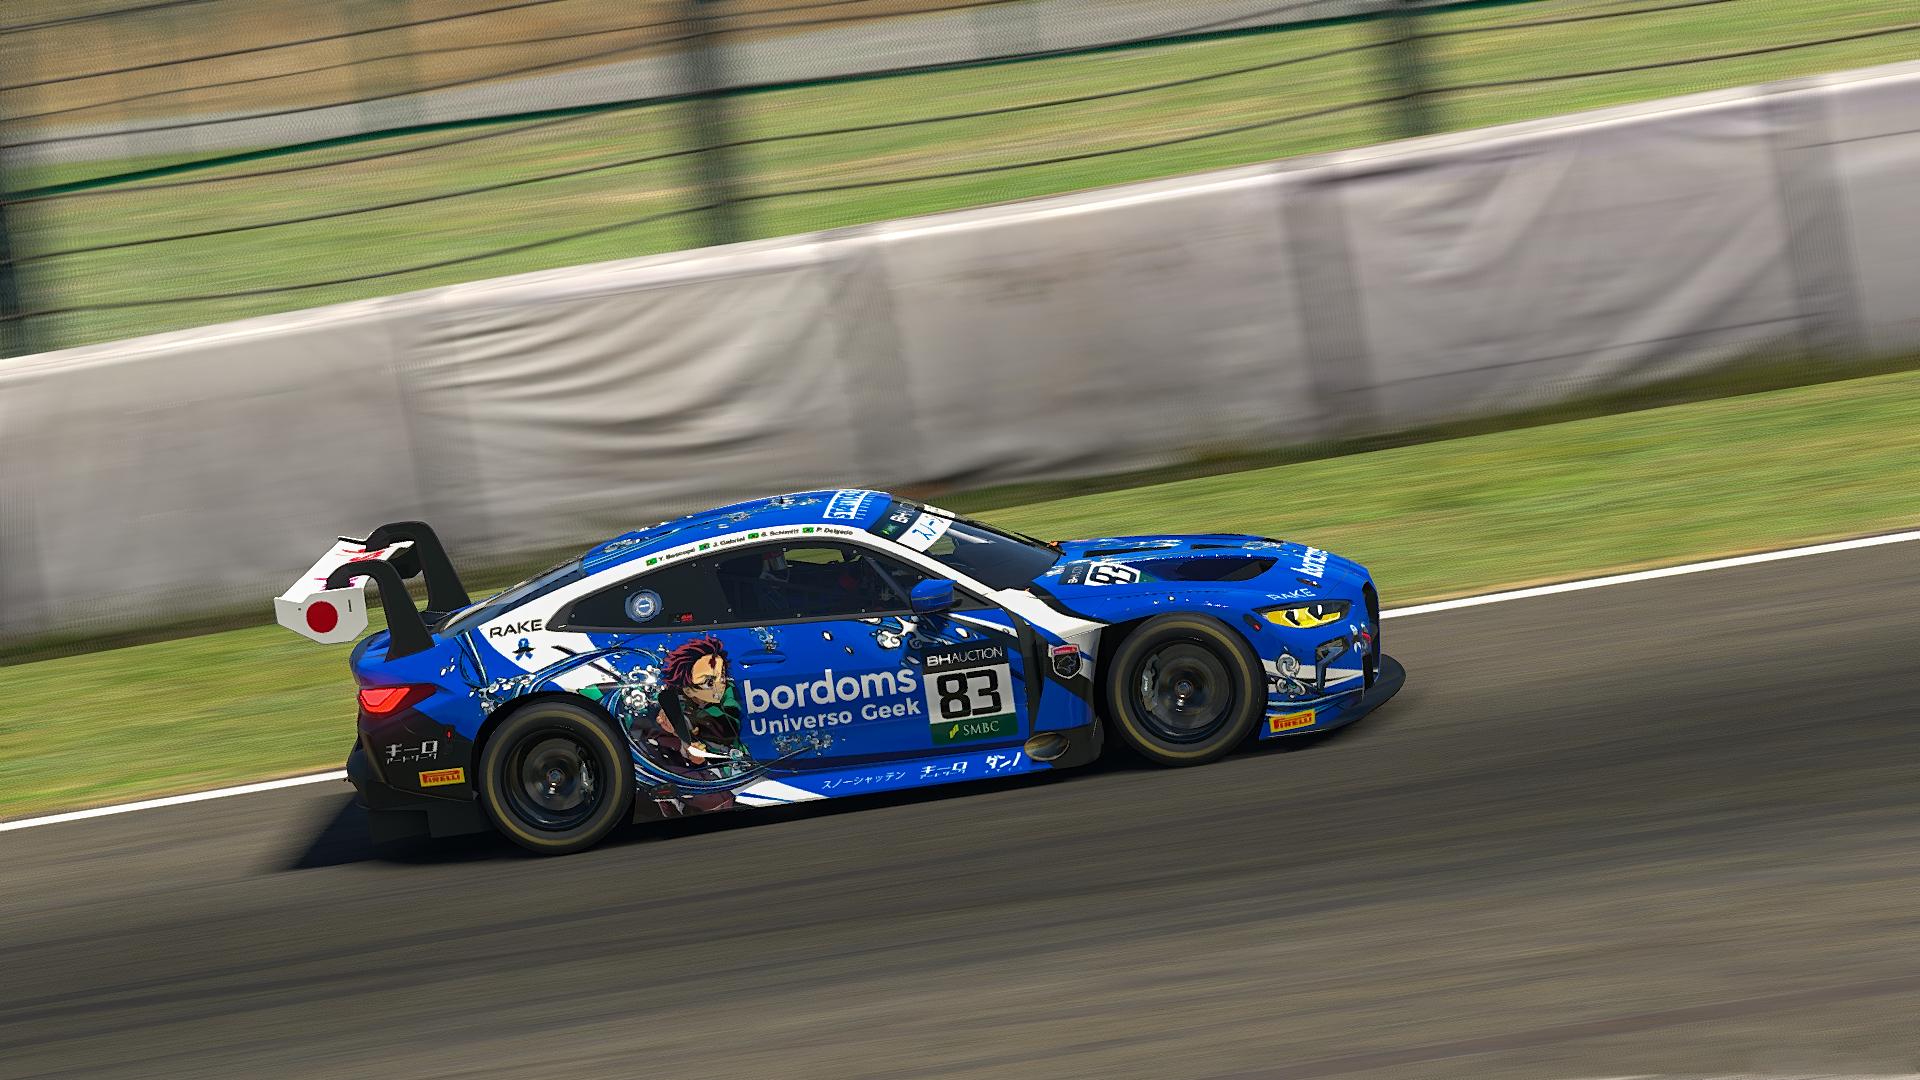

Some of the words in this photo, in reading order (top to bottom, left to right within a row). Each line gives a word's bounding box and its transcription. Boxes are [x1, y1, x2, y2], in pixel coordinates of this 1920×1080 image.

[1265, 588, 1317, 601] RAKE
[490, 618, 543, 638] RAKE
[743, 668, 918, 715] bordoms
[936, 668, 1002, 720] 83
[750, 710, 853, 736] Universo
[861, 697, 922, 721] Geek
[1273, 712, 1313, 729] PIRELLI
[963, 720, 1000, 736] SMBC
[422, 769, 461, 784] PIRELLI
